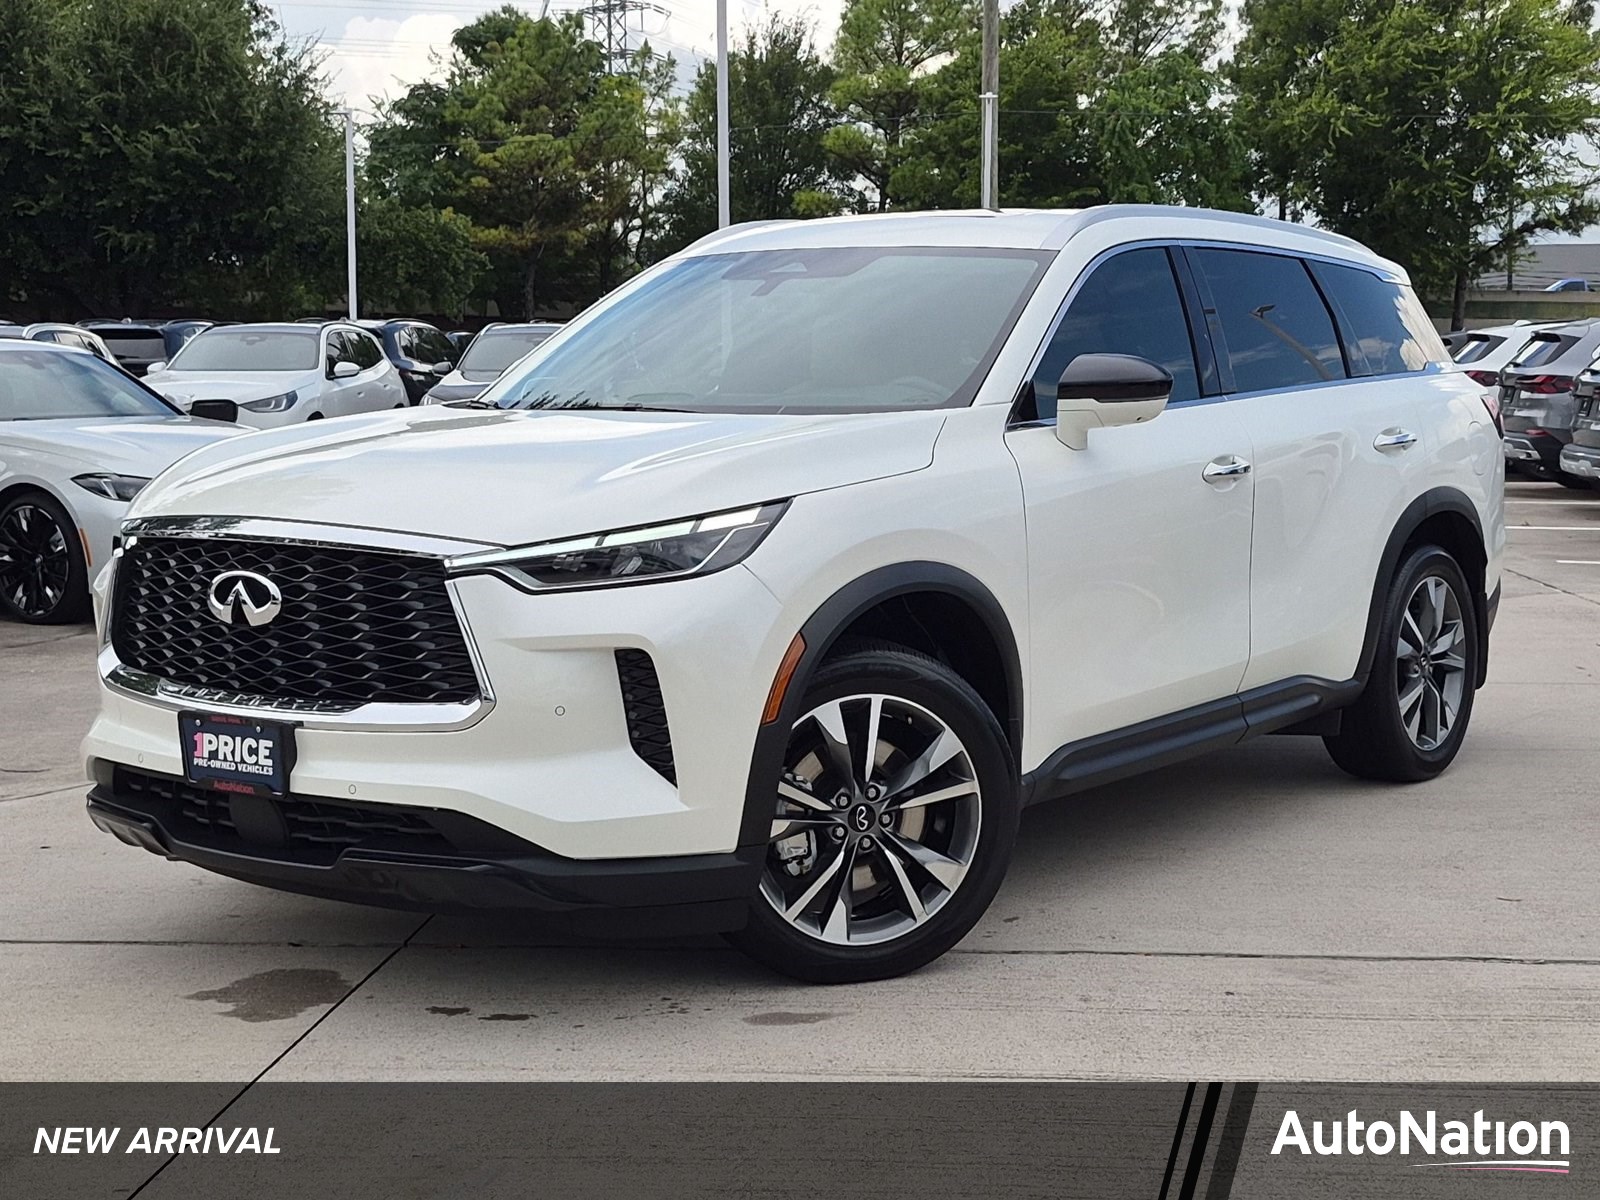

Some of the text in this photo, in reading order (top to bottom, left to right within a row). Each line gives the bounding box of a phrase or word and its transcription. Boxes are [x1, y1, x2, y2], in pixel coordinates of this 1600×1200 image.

[193, 732, 273, 766] 1PRICE
[193, 758, 273, 775] PRE-OWNED VEHICLES
